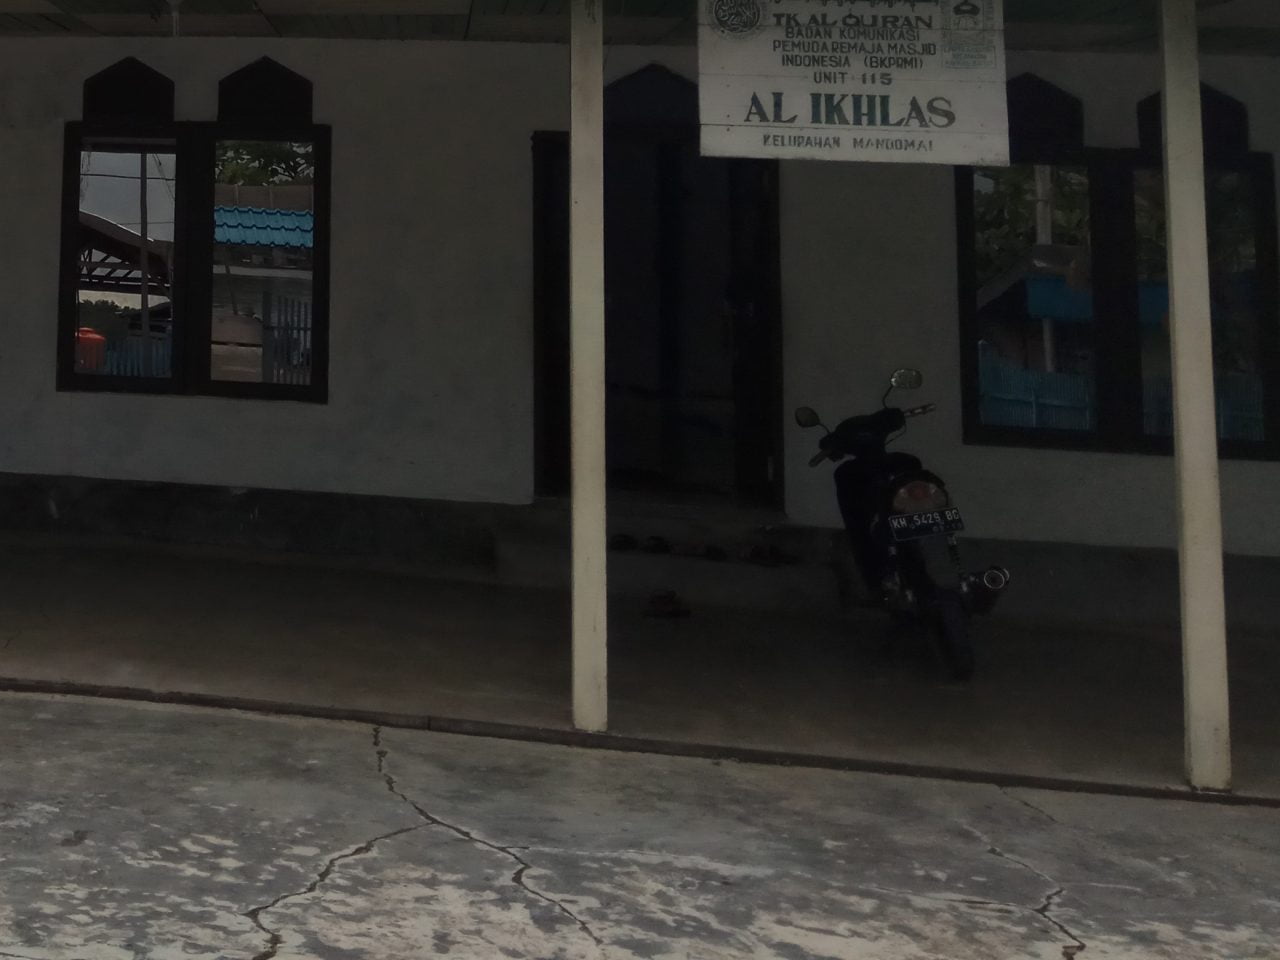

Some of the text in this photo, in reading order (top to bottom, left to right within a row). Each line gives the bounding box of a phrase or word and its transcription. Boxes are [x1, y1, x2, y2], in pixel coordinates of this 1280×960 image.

[772, 13, 800, 27] TK
[807, 13, 838, 27] AL
[785, 27, 920, 41] BADAN KOMUNIKASI
[772, 40, 937, 56] PEMUDA REMAJA MASJID
[781, 55, 851, 68] INDONESIA
[813, 72, 893, 86] UNIT 115
[744, 91, 956, 128] AL IKHLAS
[762, 134, 841, 149] KELURAHAN
[891, 517, 908, 529] KH
